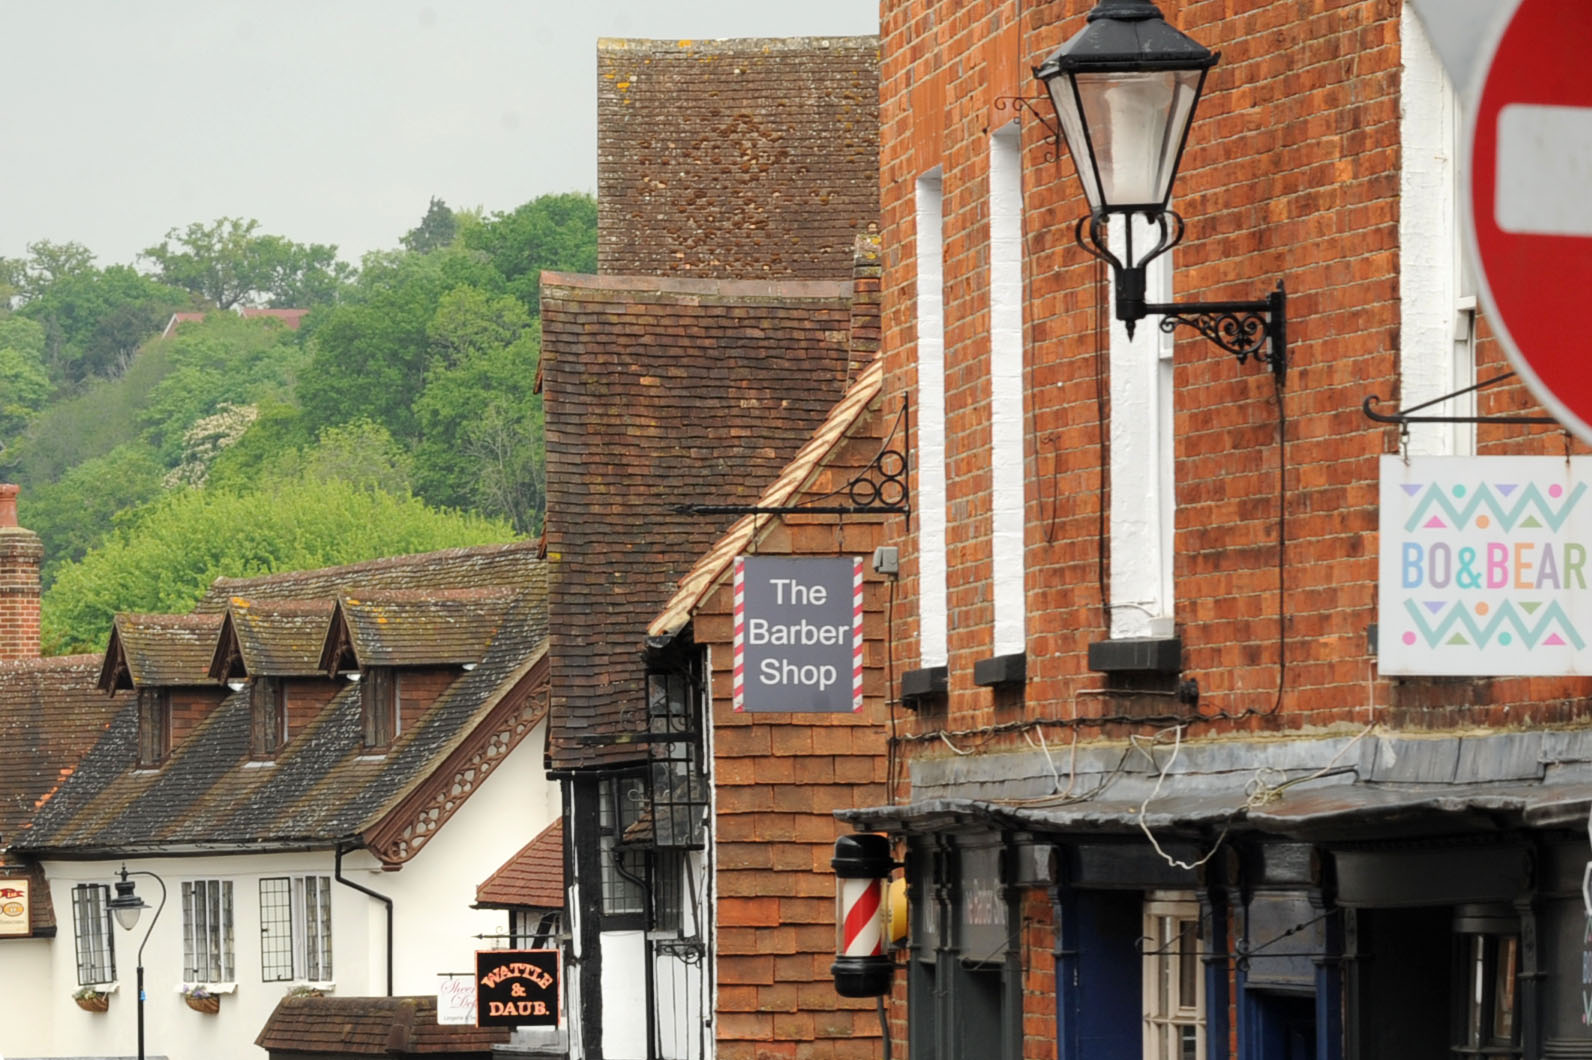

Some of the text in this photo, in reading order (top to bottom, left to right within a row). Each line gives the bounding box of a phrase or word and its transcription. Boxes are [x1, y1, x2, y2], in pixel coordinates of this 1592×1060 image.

[769, 578, 827, 606] The
[748, 618, 850, 646] Barber
[759, 657, 838, 692] Shop
[480, 962, 554, 990] WATTLE
[511, 982, 527, 998] &
[489, 1001, 550, 1017] DAUB.
